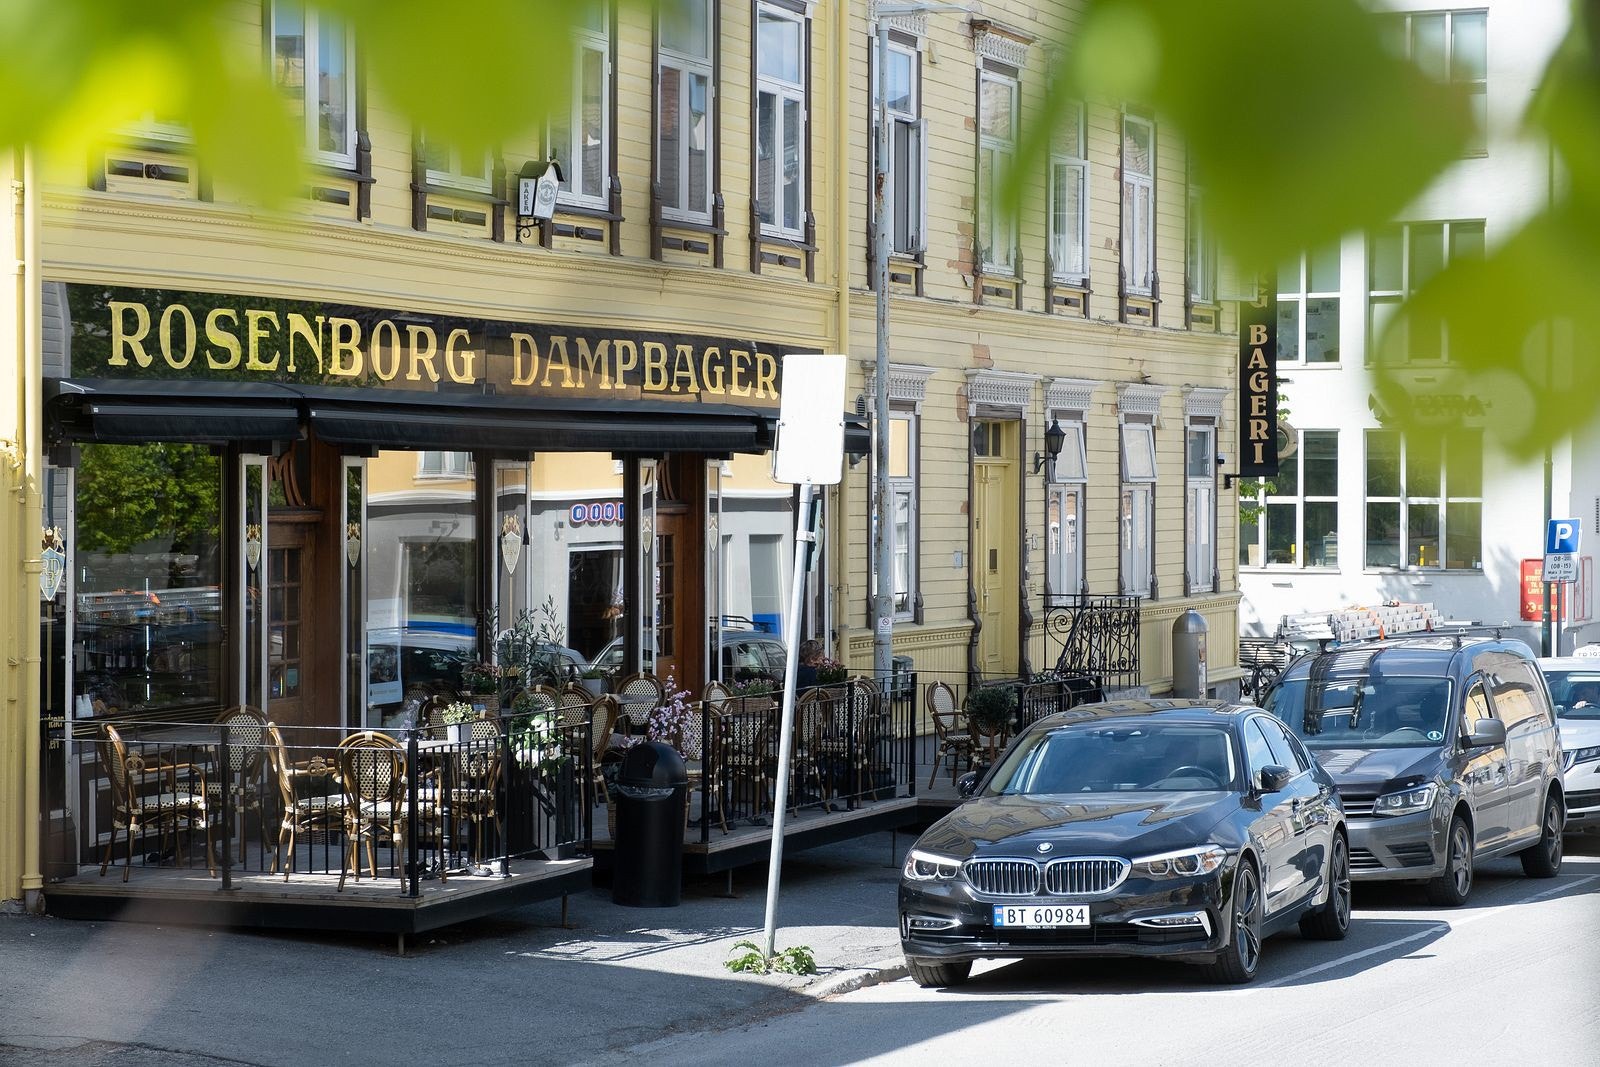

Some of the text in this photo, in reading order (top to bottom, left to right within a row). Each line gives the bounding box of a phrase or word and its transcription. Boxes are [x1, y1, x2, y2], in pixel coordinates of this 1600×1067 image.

[107, 300, 784, 401] ROSENBORG DAMPBAGER
[1248, 324, 1270, 465] BAGERI
[1554, 523, 1573, 549] P
[1007, 908, 1027, 924] BT
[1034, 908, 1085, 924] 60984
